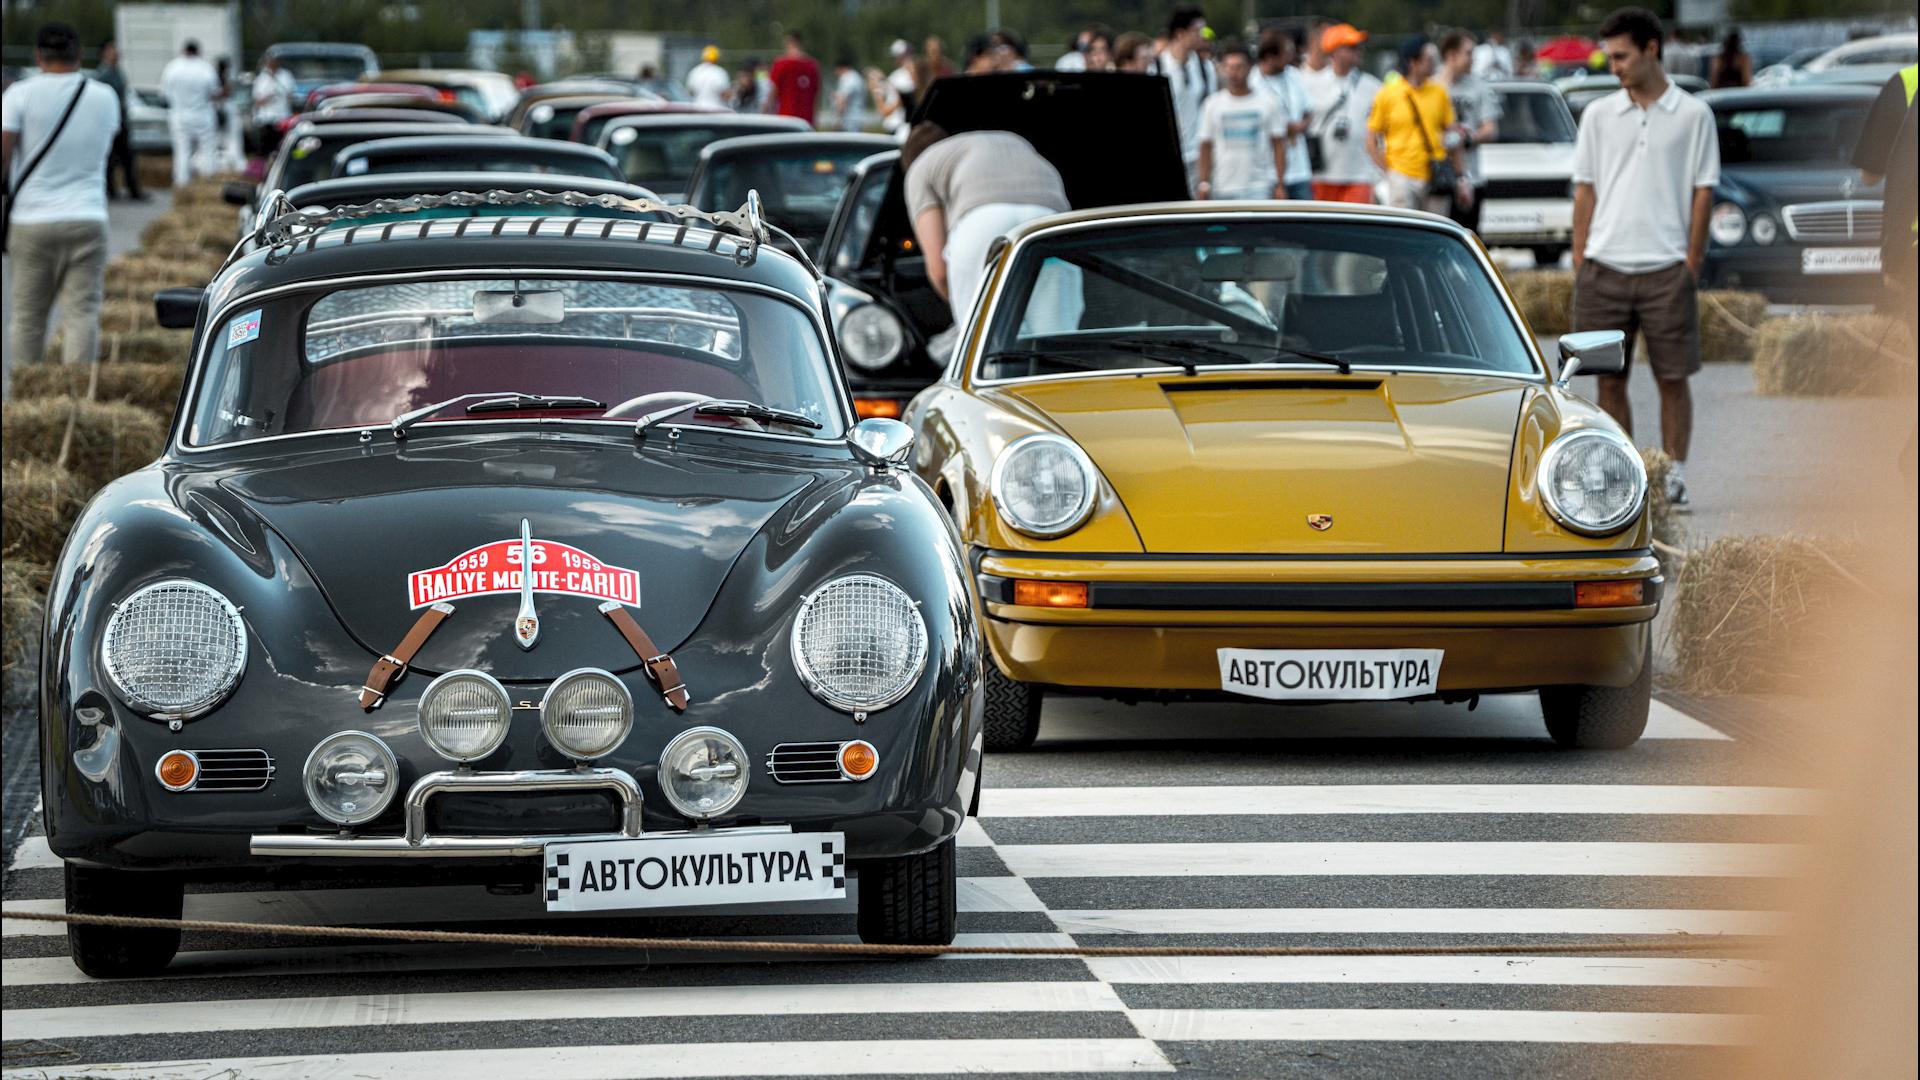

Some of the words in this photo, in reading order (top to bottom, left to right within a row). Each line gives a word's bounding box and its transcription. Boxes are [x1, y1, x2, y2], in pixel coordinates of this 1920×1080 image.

[449, 551, 488, 572] 1959
[506, 545, 547, 564] 56
[562, 551, 600, 571] 1959
[418, 572, 486, 603] RALLYE
[1230, 658, 1430, 689] АВТОКУЛЬТУРА
[579, 850, 813, 892] АВТОКУЛЬТУРА
